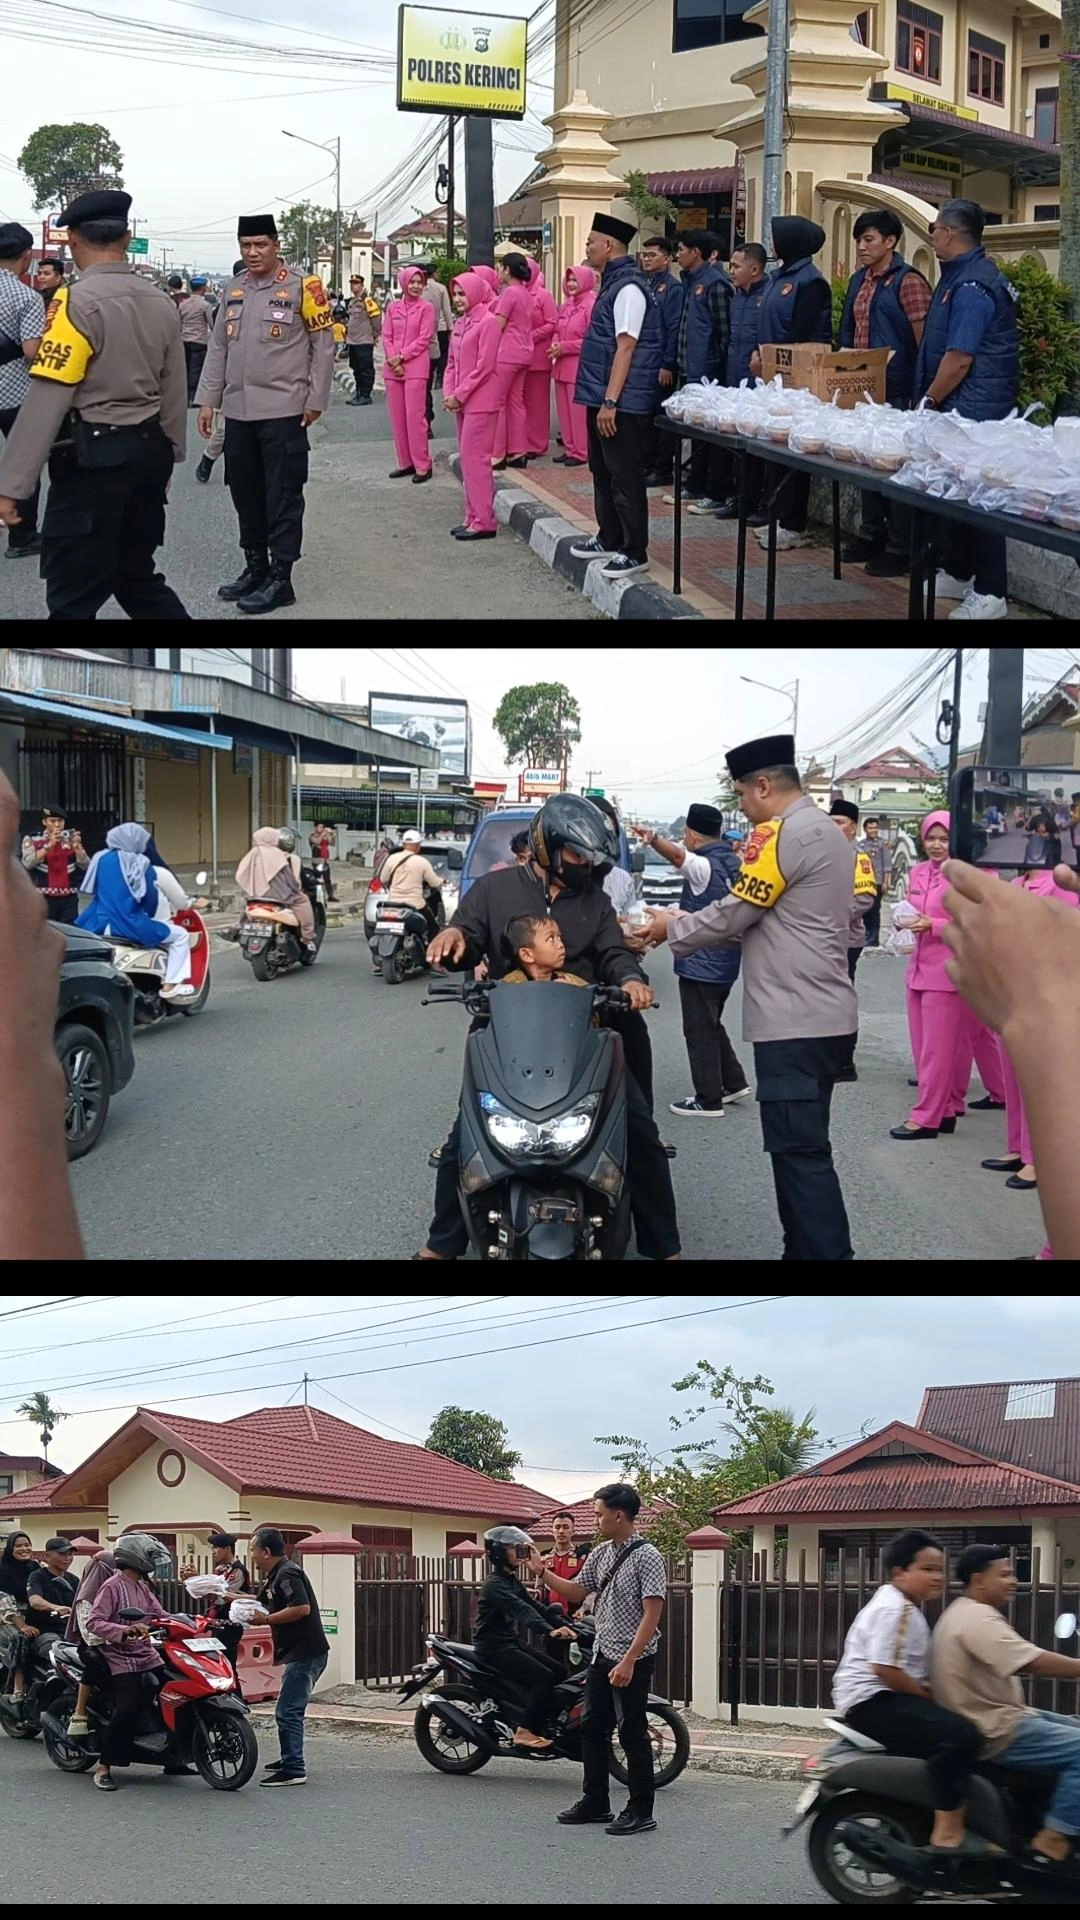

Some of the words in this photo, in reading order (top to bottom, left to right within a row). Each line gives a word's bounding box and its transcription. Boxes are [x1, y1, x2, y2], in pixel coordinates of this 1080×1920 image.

[407, 58, 462, 85] POLRES
[464, 63, 520, 90] KERINCI
[912, 93, 937, 108] SELAMAT
[937, 101, 957, 115] DATANG
[268, 299, 293, 308] POLRI
[541, 773, 559, 781] MART
[737, 872, 774, 903] SRES
